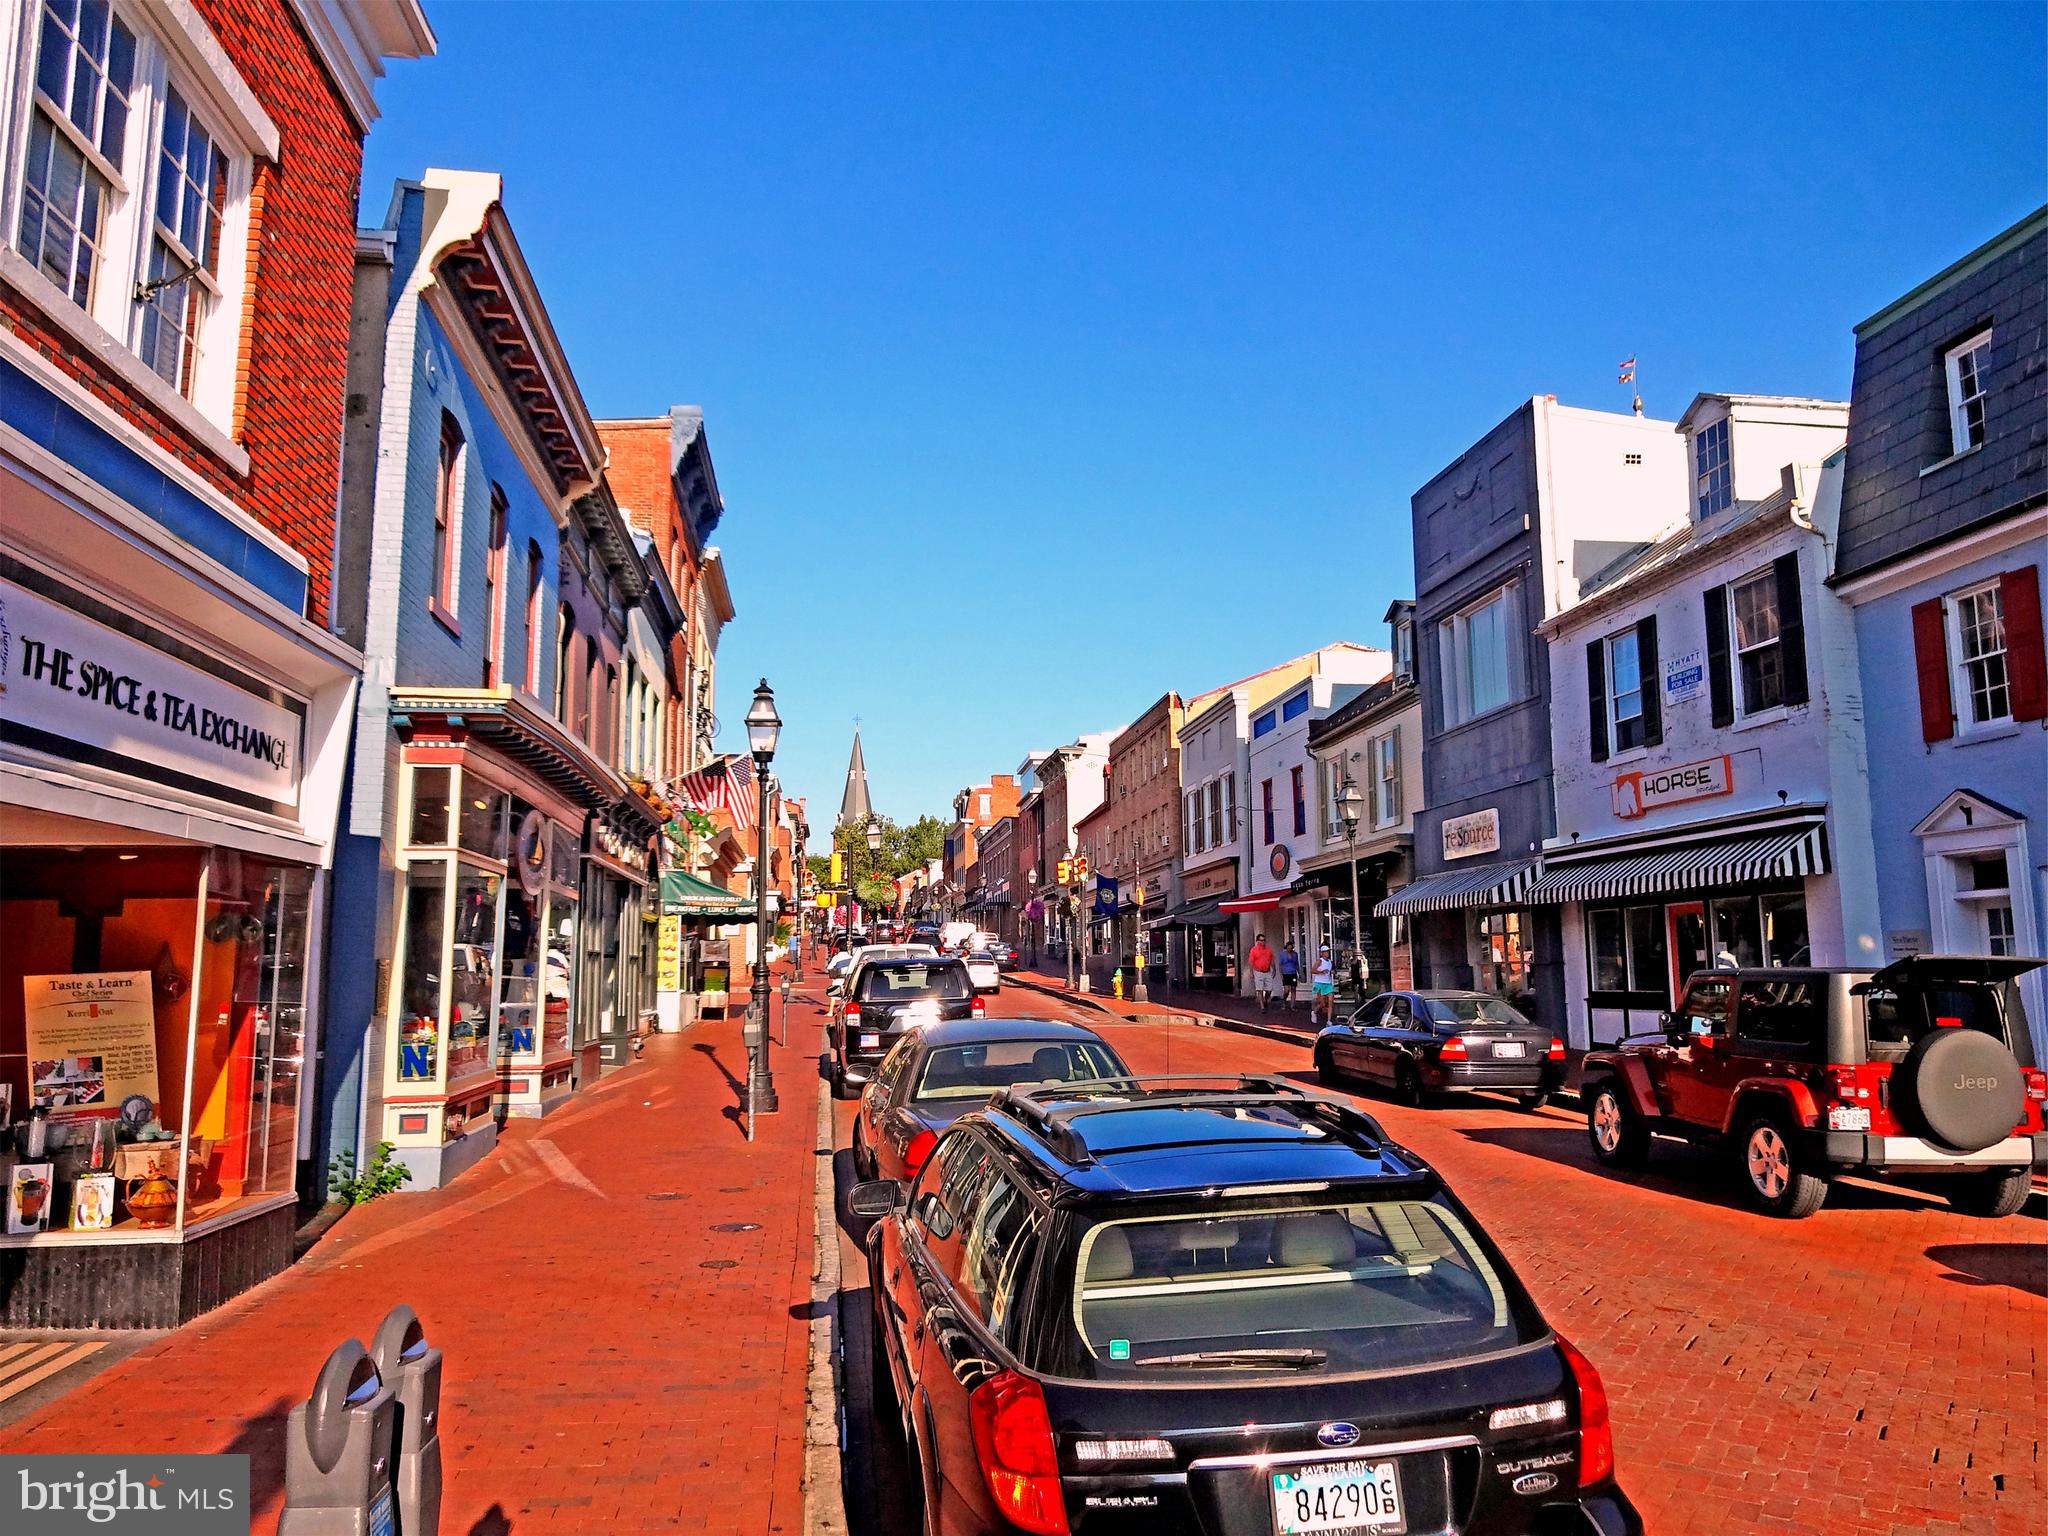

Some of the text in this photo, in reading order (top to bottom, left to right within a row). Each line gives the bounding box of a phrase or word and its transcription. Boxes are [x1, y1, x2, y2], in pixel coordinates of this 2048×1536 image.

[1676, 651, 1700, 667] HYATT
[1671, 668, 1698, 682] BUILDING
[1671, 680, 1683, 689] FOR
[1684, 675, 1699, 685] SALE
[20, 635, 75, 692] THE
[77, 659, 142, 716] SPICE
[144, 690, 158, 722] &
[162, 692, 198, 736] TEA
[1644, 766, 1712, 796] HORSE
[49, 978, 133, 991] Taste & Learn
[513, 1028, 533, 1052] N
[402, 1045, 429, 1077] N
[1954, 1074, 1998, 1092] Jeep
[1300, 1460, 1367, 1477] SAVE THE BAY
[1497, 1451, 1574, 1474] OUTBACK
[1086, 1496, 1158, 1507] SUBARU
[1296, 1481, 1379, 1523] 84290
